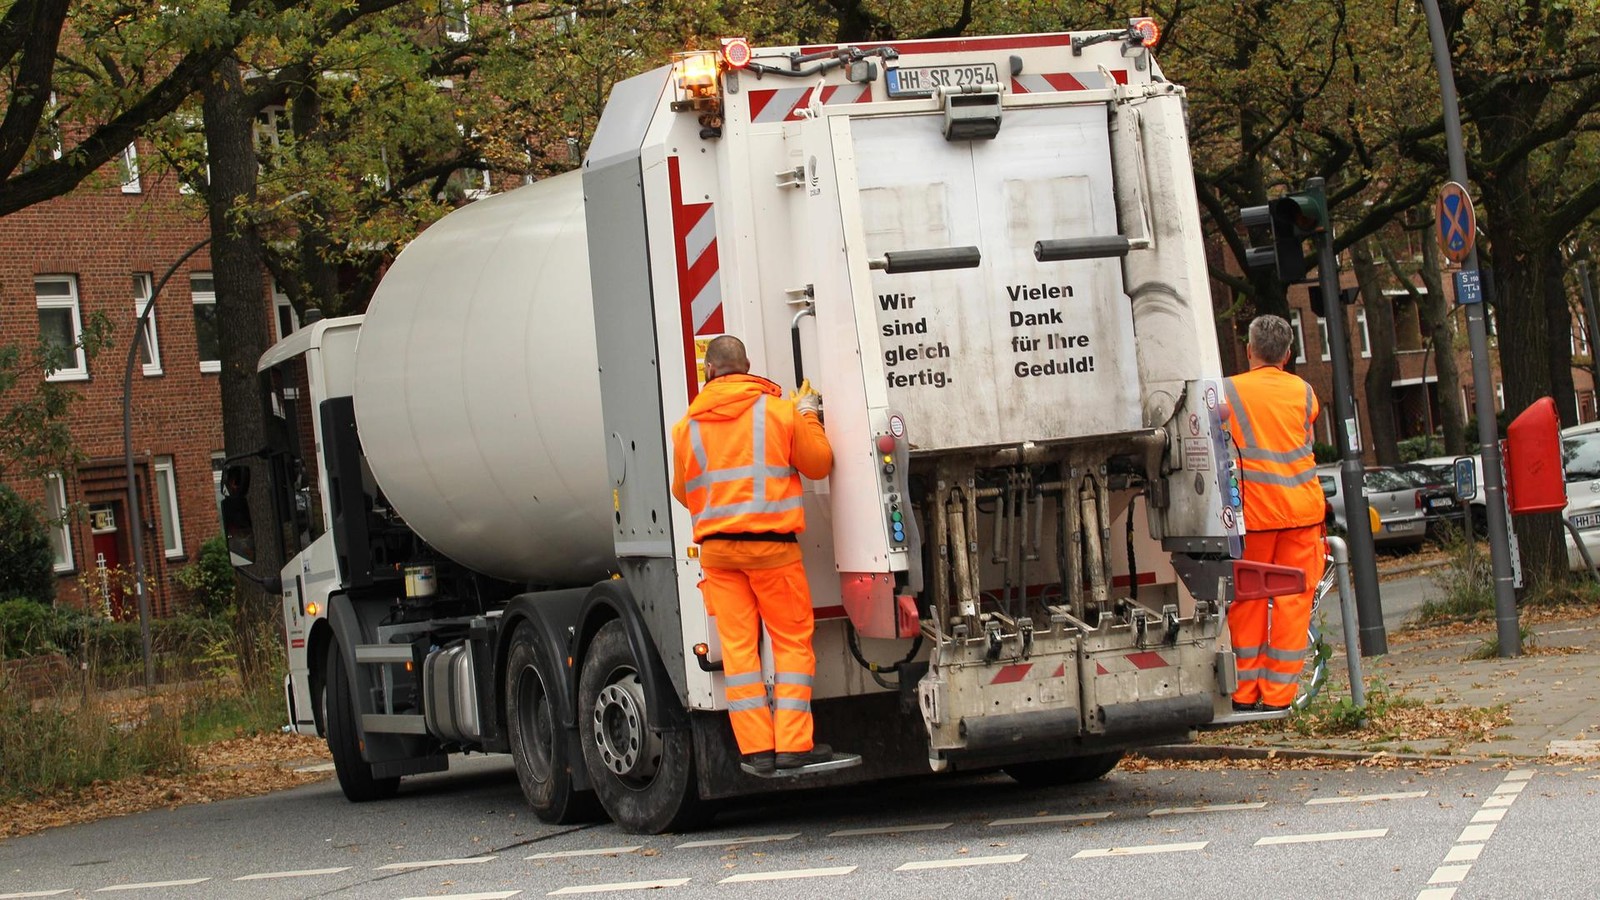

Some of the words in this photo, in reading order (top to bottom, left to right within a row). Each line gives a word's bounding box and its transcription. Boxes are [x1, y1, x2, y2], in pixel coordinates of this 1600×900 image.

[898, 71, 920, 90] HH
[930, 69, 951, 88] SR
[955, 66, 994, 86] 2954
[879, 293, 916, 311] Wir
[1006, 283, 1073, 301] Vielen
[882, 317, 927, 337] sind
[1010, 308, 1063, 327] Dank
[1011, 336, 1040, 353] für
[1047, 333, 1089, 350] Ihre
[884, 342, 950, 366] gleich
[1014, 356, 1094, 378] Geduld!
[886, 368, 953, 388] fertig.
[1575, 515, 1589, 527] HH
